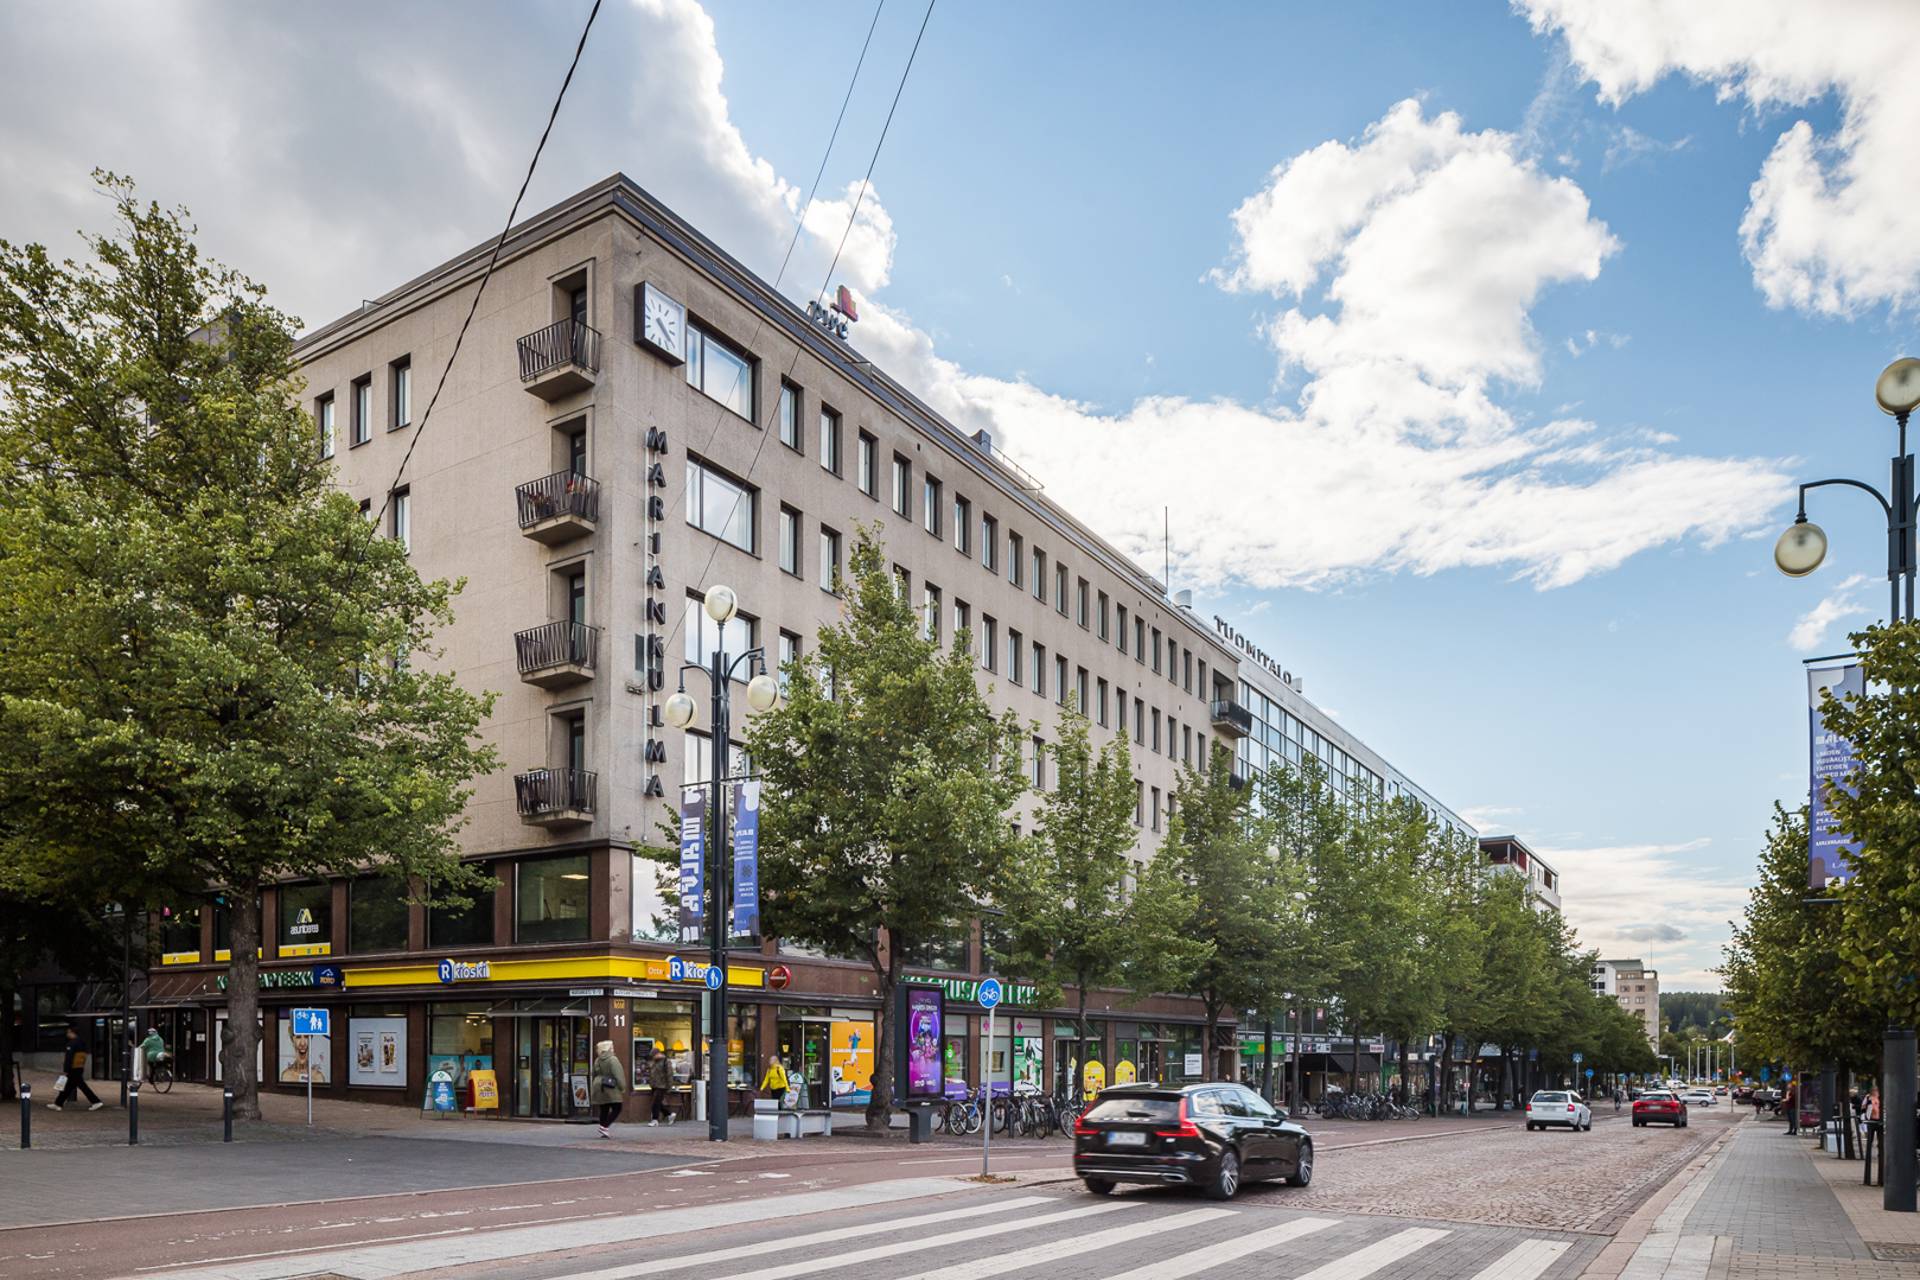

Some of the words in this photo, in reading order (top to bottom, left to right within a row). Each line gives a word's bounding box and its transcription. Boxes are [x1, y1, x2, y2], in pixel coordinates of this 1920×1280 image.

[646, 425, 668, 798] MARIANKULMA
[453, 963, 489, 978] kioski
[613, 1014, 625, 1027] 11
